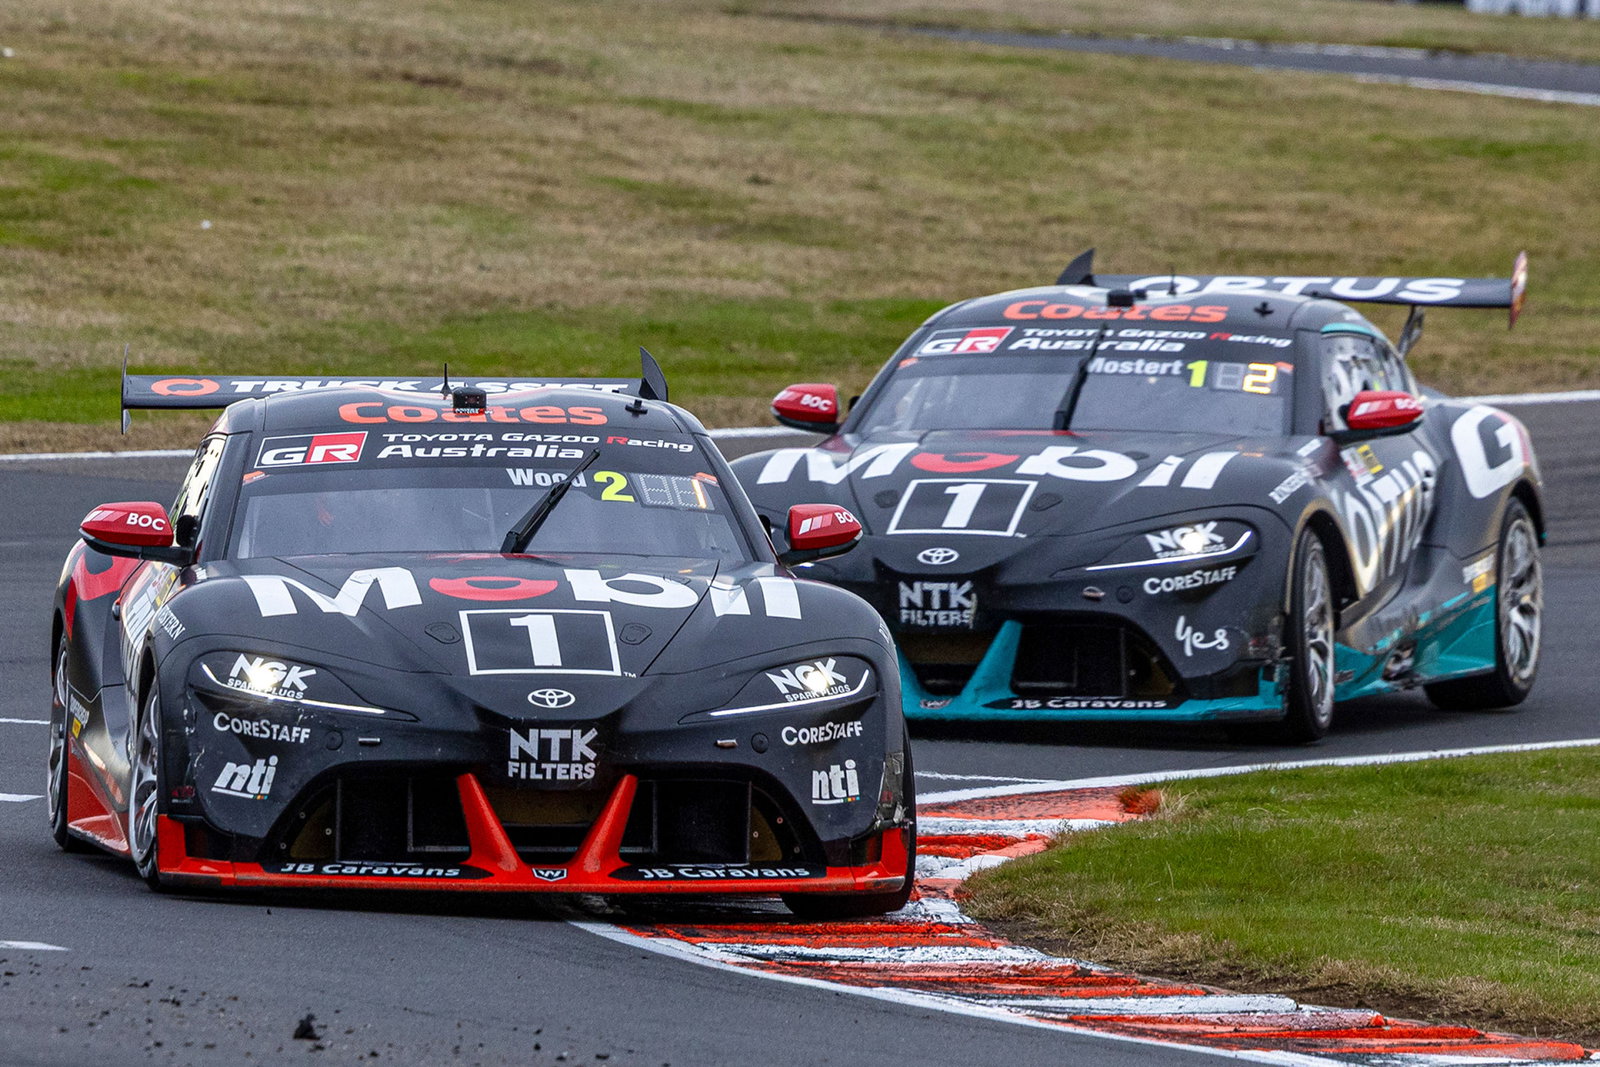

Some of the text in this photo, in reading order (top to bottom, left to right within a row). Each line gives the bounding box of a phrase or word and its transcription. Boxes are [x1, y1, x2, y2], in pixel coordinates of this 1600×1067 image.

[1003, 300, 1230, 323] Coates
[920, 336, 1001, 354] GR
[1008, 337, 1186, 352] Australia
[1117, 328, 1207, 340] GAZOO
[1209, 333, 1293, 348] Racing
[1086, 357, 1208, 388] Mostert 1
[1243, 362, 1278, 394] 2
[338, 402, 608, 425] Coates
[800, 393, 833, 411] BOC
[376, 443, 584, 459] Australia
[382, 432, 694, 453] TOYOTA GAZOO Racing
[261, 443, 359, 466] GR
[757, 442, 1239, 490] Mobil
[506, 468, 635, 503] Wood 2
[834, 510, 857, 524] BO
[942, 483, 987, 528] 1
[126, 512, 166, 531] BOC
[240, 566, 802, 620] Mobil
[899, 581, 974, 609] NTK
[900, 608, 973, 627] FILTERS
[510, 613, 563, 667] 1
[229, 653, 317, 692] NGK
[765, 657, 847, 694] NGK
[227, 678, 267, 694] SPA
[785, 684, 852, 703] SPARK PLUGS
[1047, 699, 1168, 709] Caravans
[510, 728, 598, 762] NTK
[213, 755, 279, 795] nti
[508, 761, 595, 780] FILTERS
[812, 759, 860, 800] nti
[281, 863, 461, 876] JB Caravans
[638, 868, 810, 879] JB Caravans
